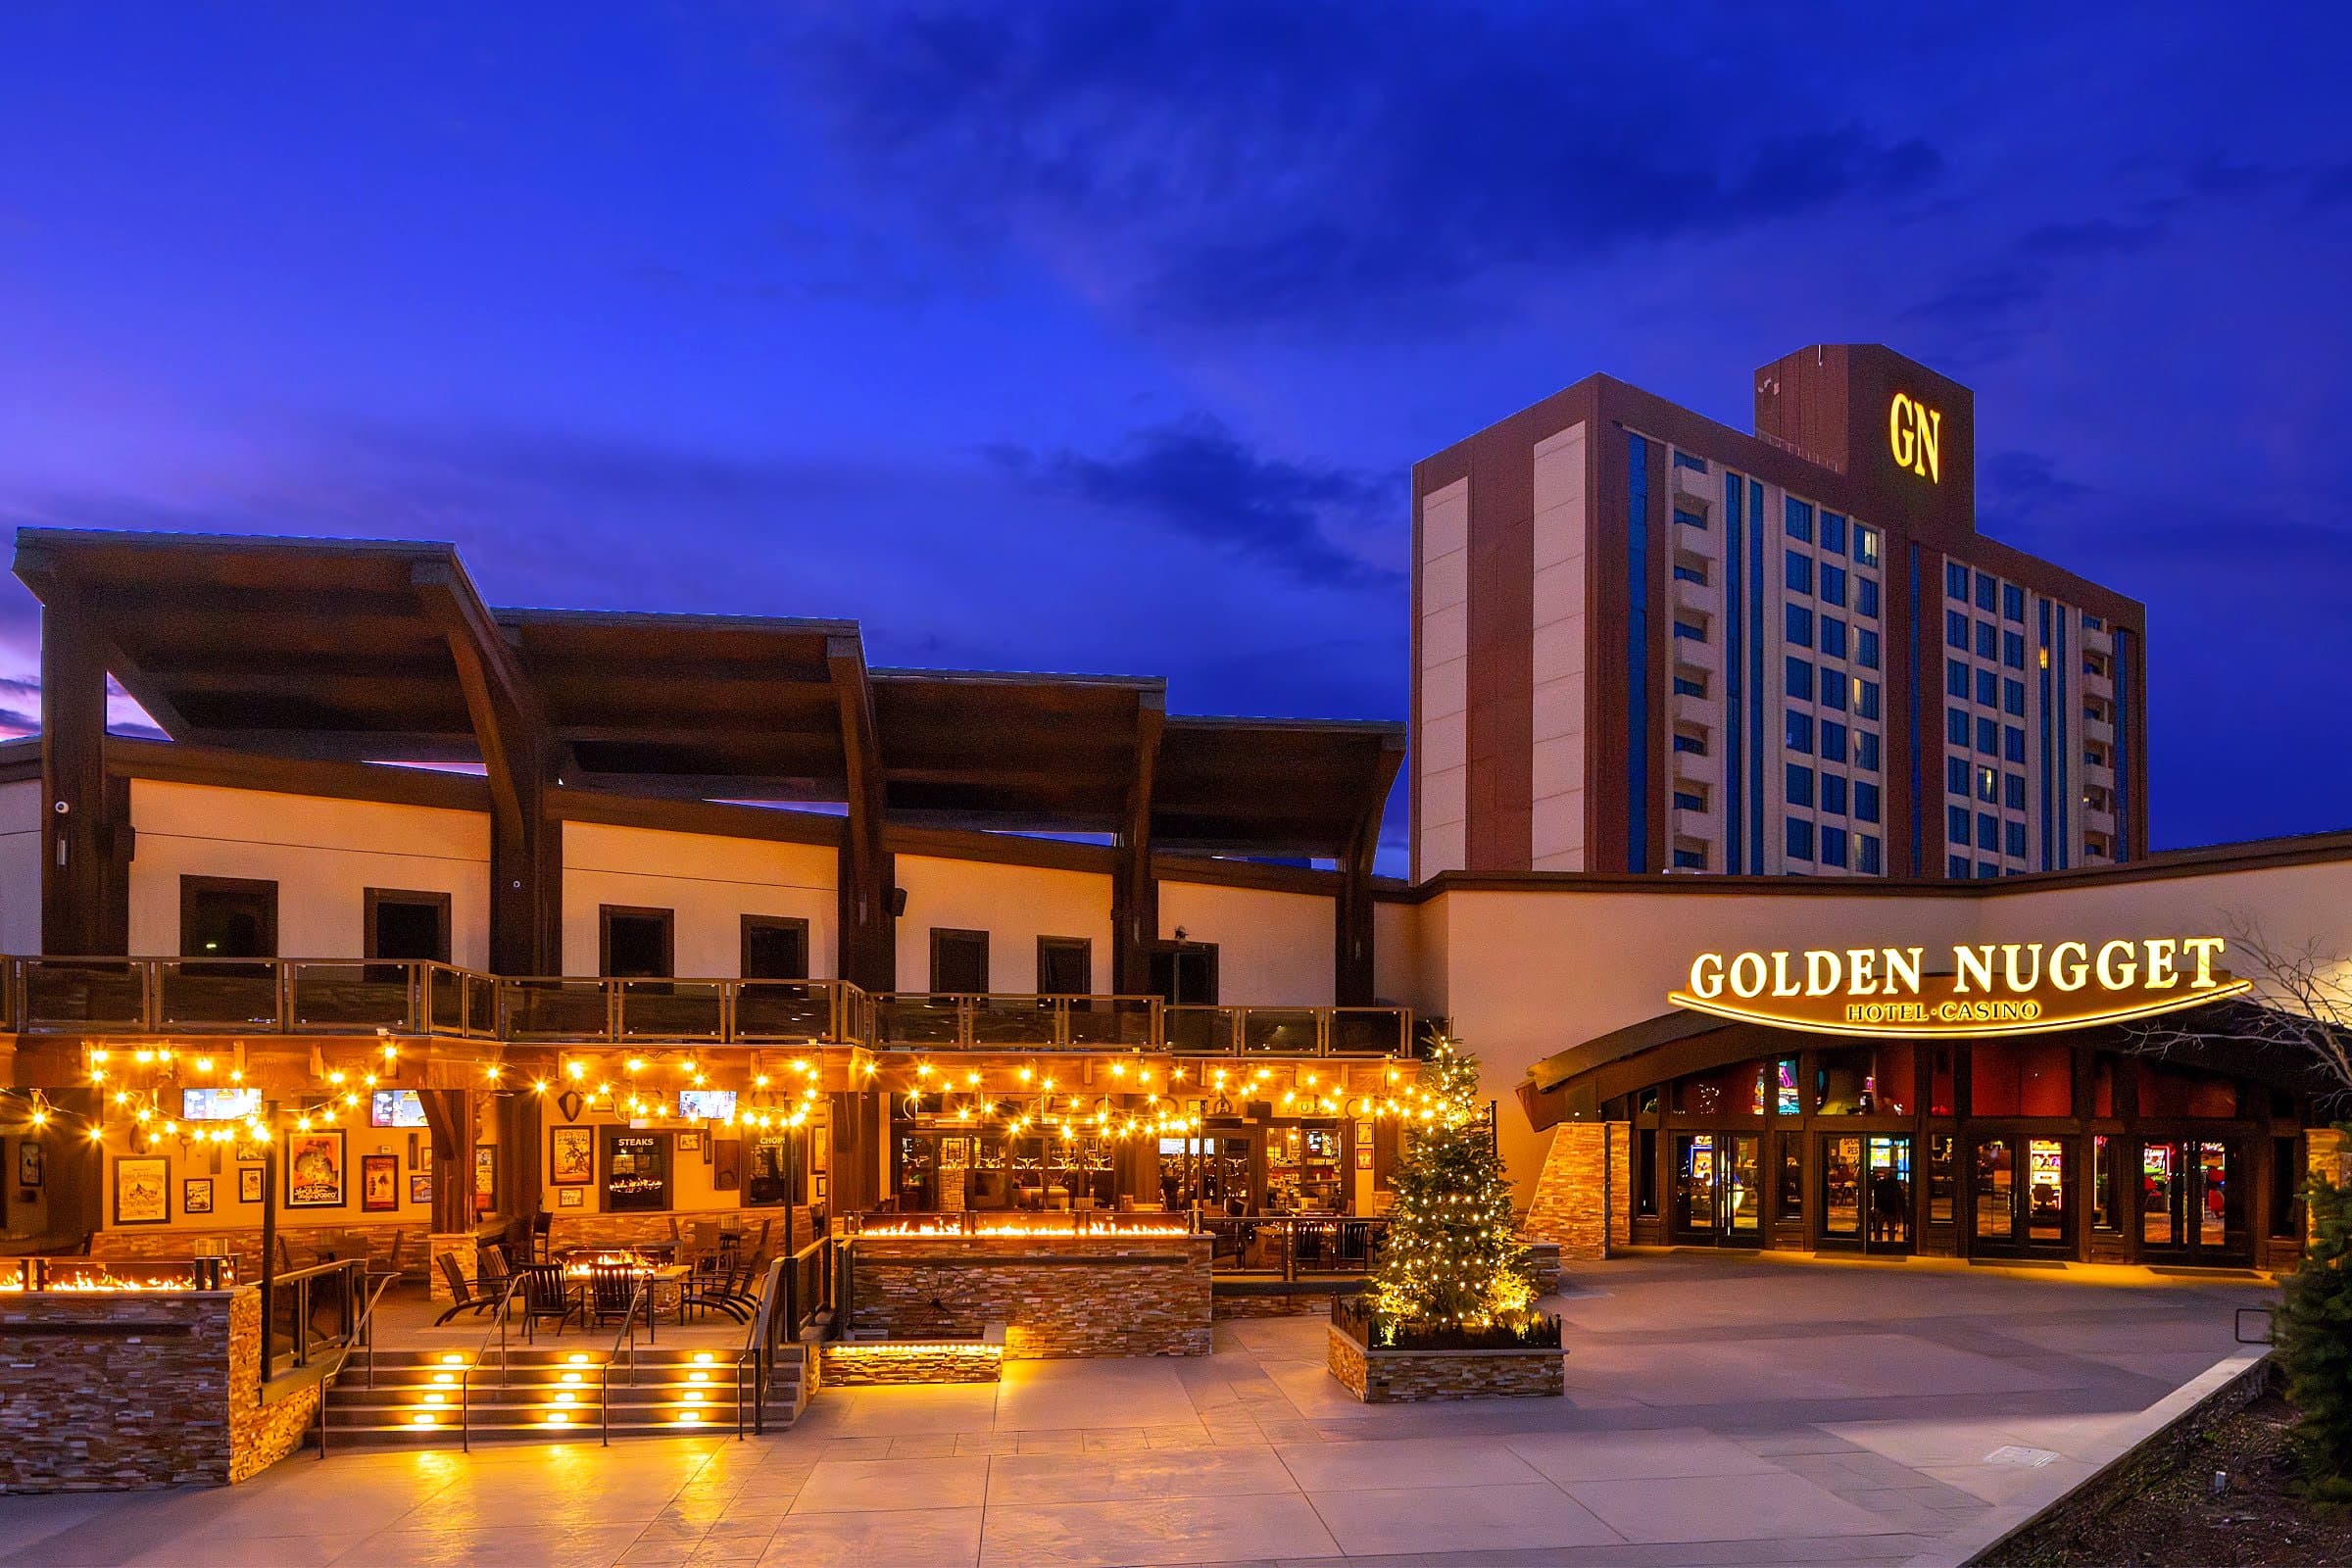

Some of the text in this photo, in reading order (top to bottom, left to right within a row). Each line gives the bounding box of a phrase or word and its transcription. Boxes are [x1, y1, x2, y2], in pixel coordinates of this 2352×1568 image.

[1890, 392, 1941, 485] GN
[1690, 937, 2227, 1000] GOLDEN NUGGET
[1847, 1002, 2040, 1021] HOTEL CASINO
[617, 1138, 655, 1147] STEAKS
